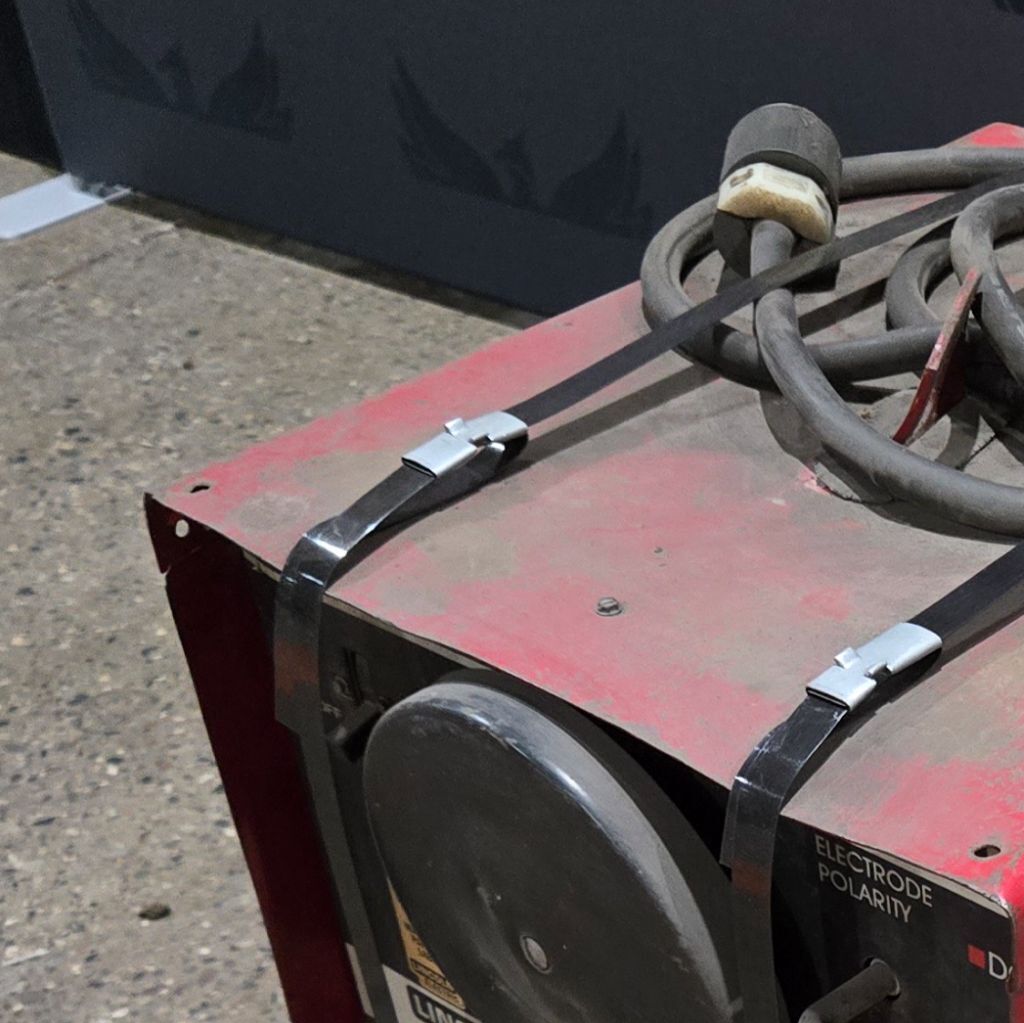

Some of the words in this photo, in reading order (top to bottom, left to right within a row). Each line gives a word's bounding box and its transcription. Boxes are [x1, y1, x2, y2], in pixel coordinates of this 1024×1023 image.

[815, 833, 933, 908] ELECTRODE
[818, 862, 912, 923] POLARITY
[988, 951, 1013, 981] D
